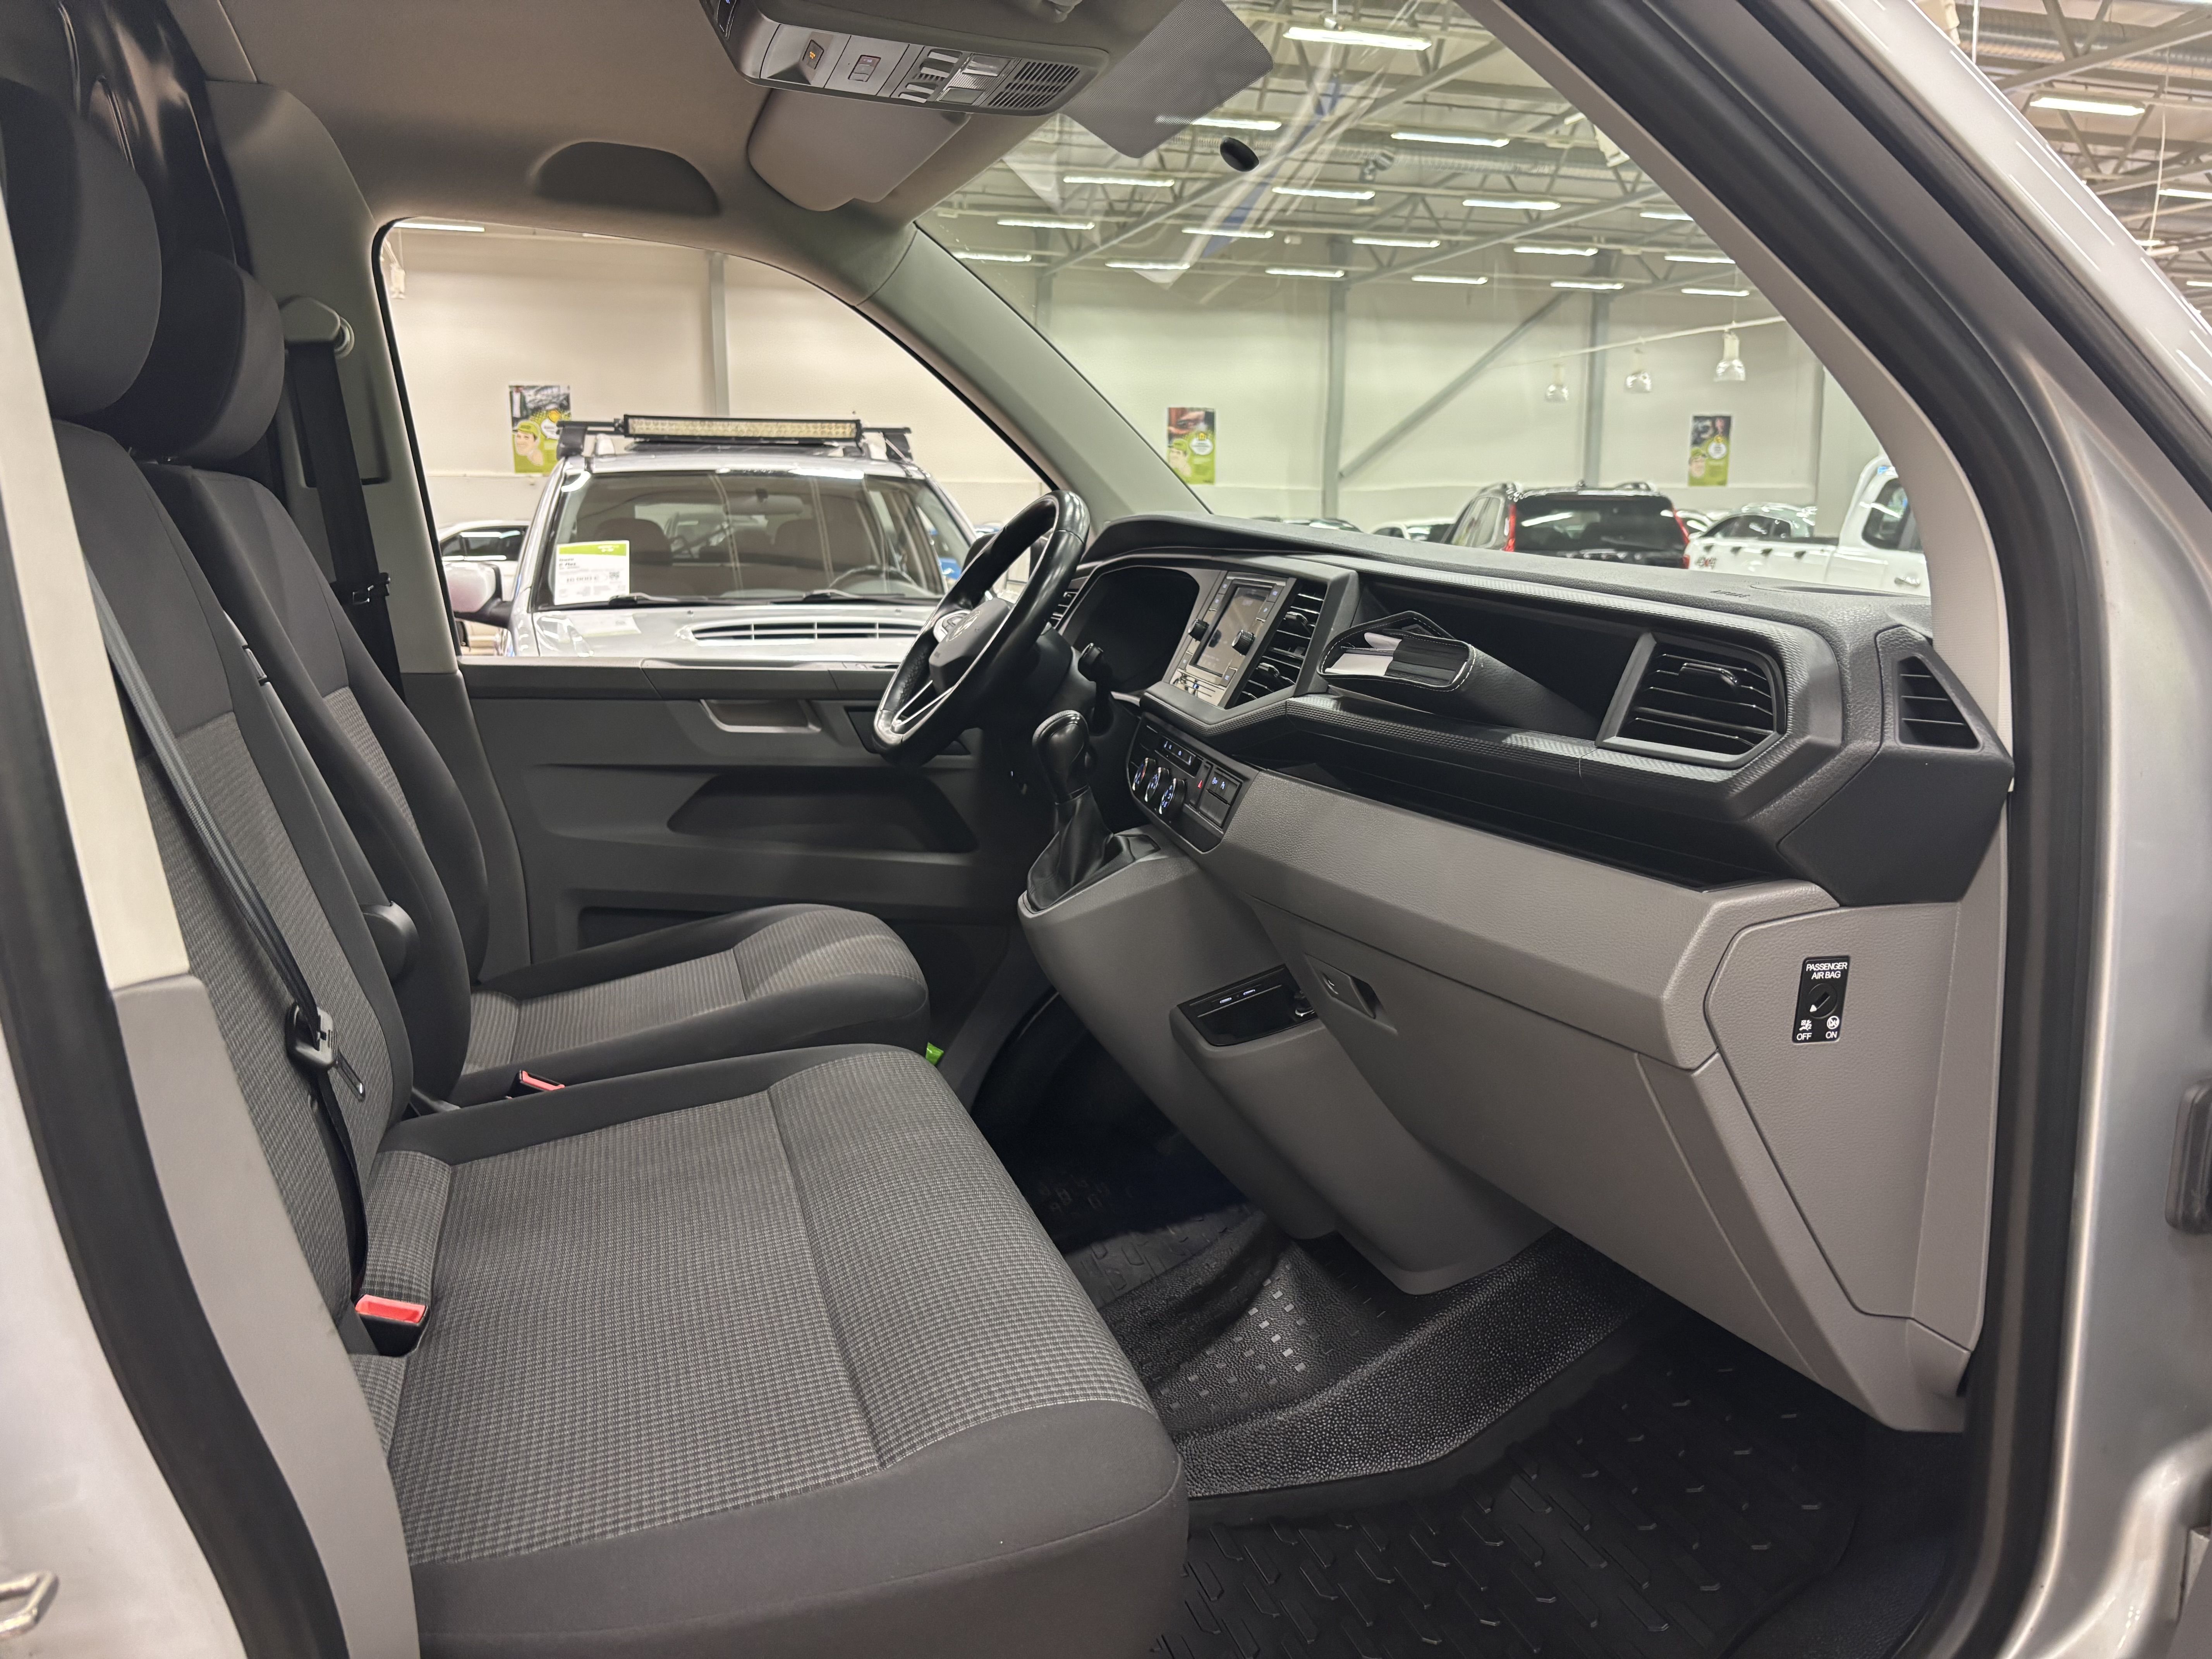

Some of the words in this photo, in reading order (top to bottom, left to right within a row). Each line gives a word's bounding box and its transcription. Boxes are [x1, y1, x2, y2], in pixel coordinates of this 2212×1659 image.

[1806, 962, 1848, 971] PASSENGER
[1811, 972, 1824, 980] AIR
[1825, 970, 1841, 979] BAG
[1796, 1032, 1812, 1041] OFF
[1825, 1031, 1838, 1039] ON
